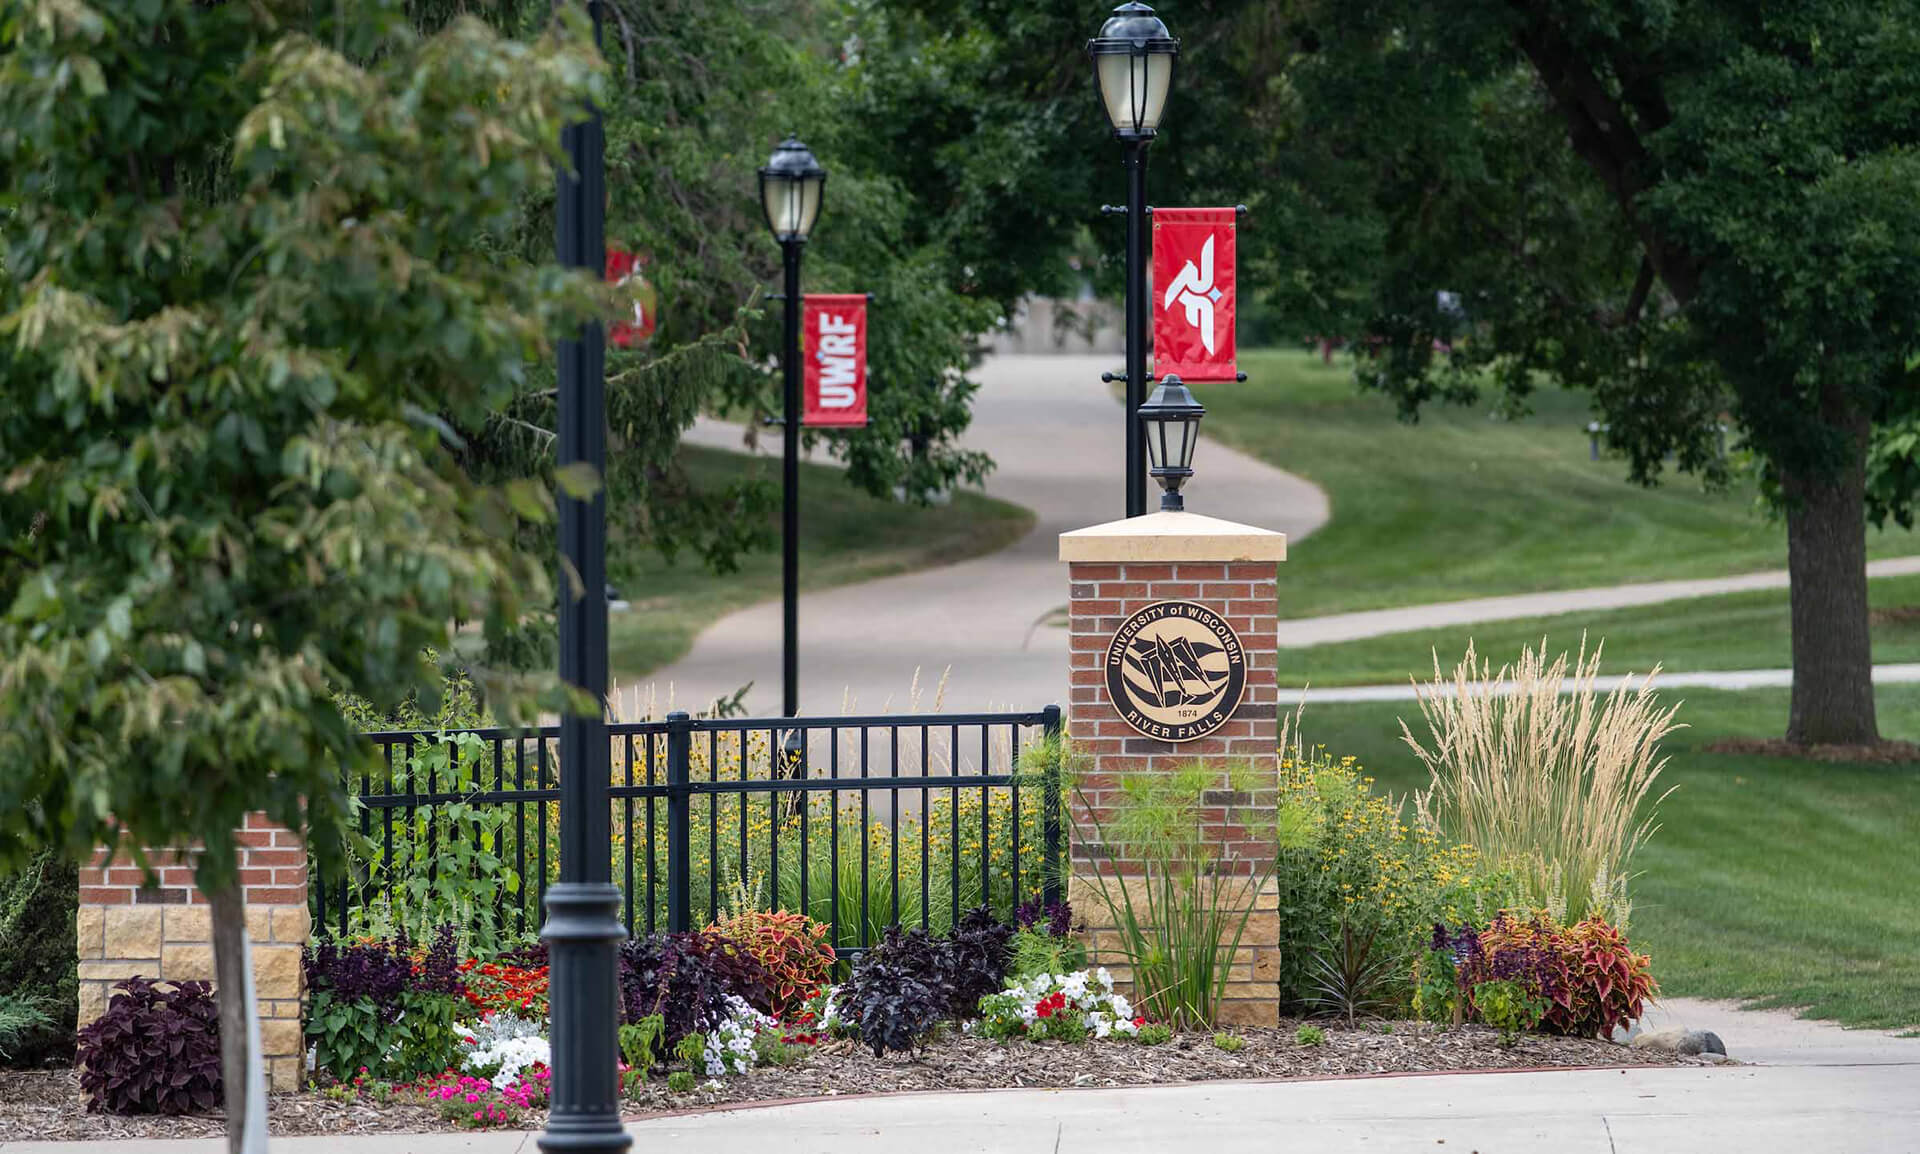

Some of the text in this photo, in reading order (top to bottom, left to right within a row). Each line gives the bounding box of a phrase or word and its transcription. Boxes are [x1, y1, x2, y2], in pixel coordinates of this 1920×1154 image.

[818, 312, 857, 408] UWRF
[1110, 606, 1241, 666] UNIVERSITY of WISCONSIN
[1127, 711, 1224, 738] RIVER FALLS
